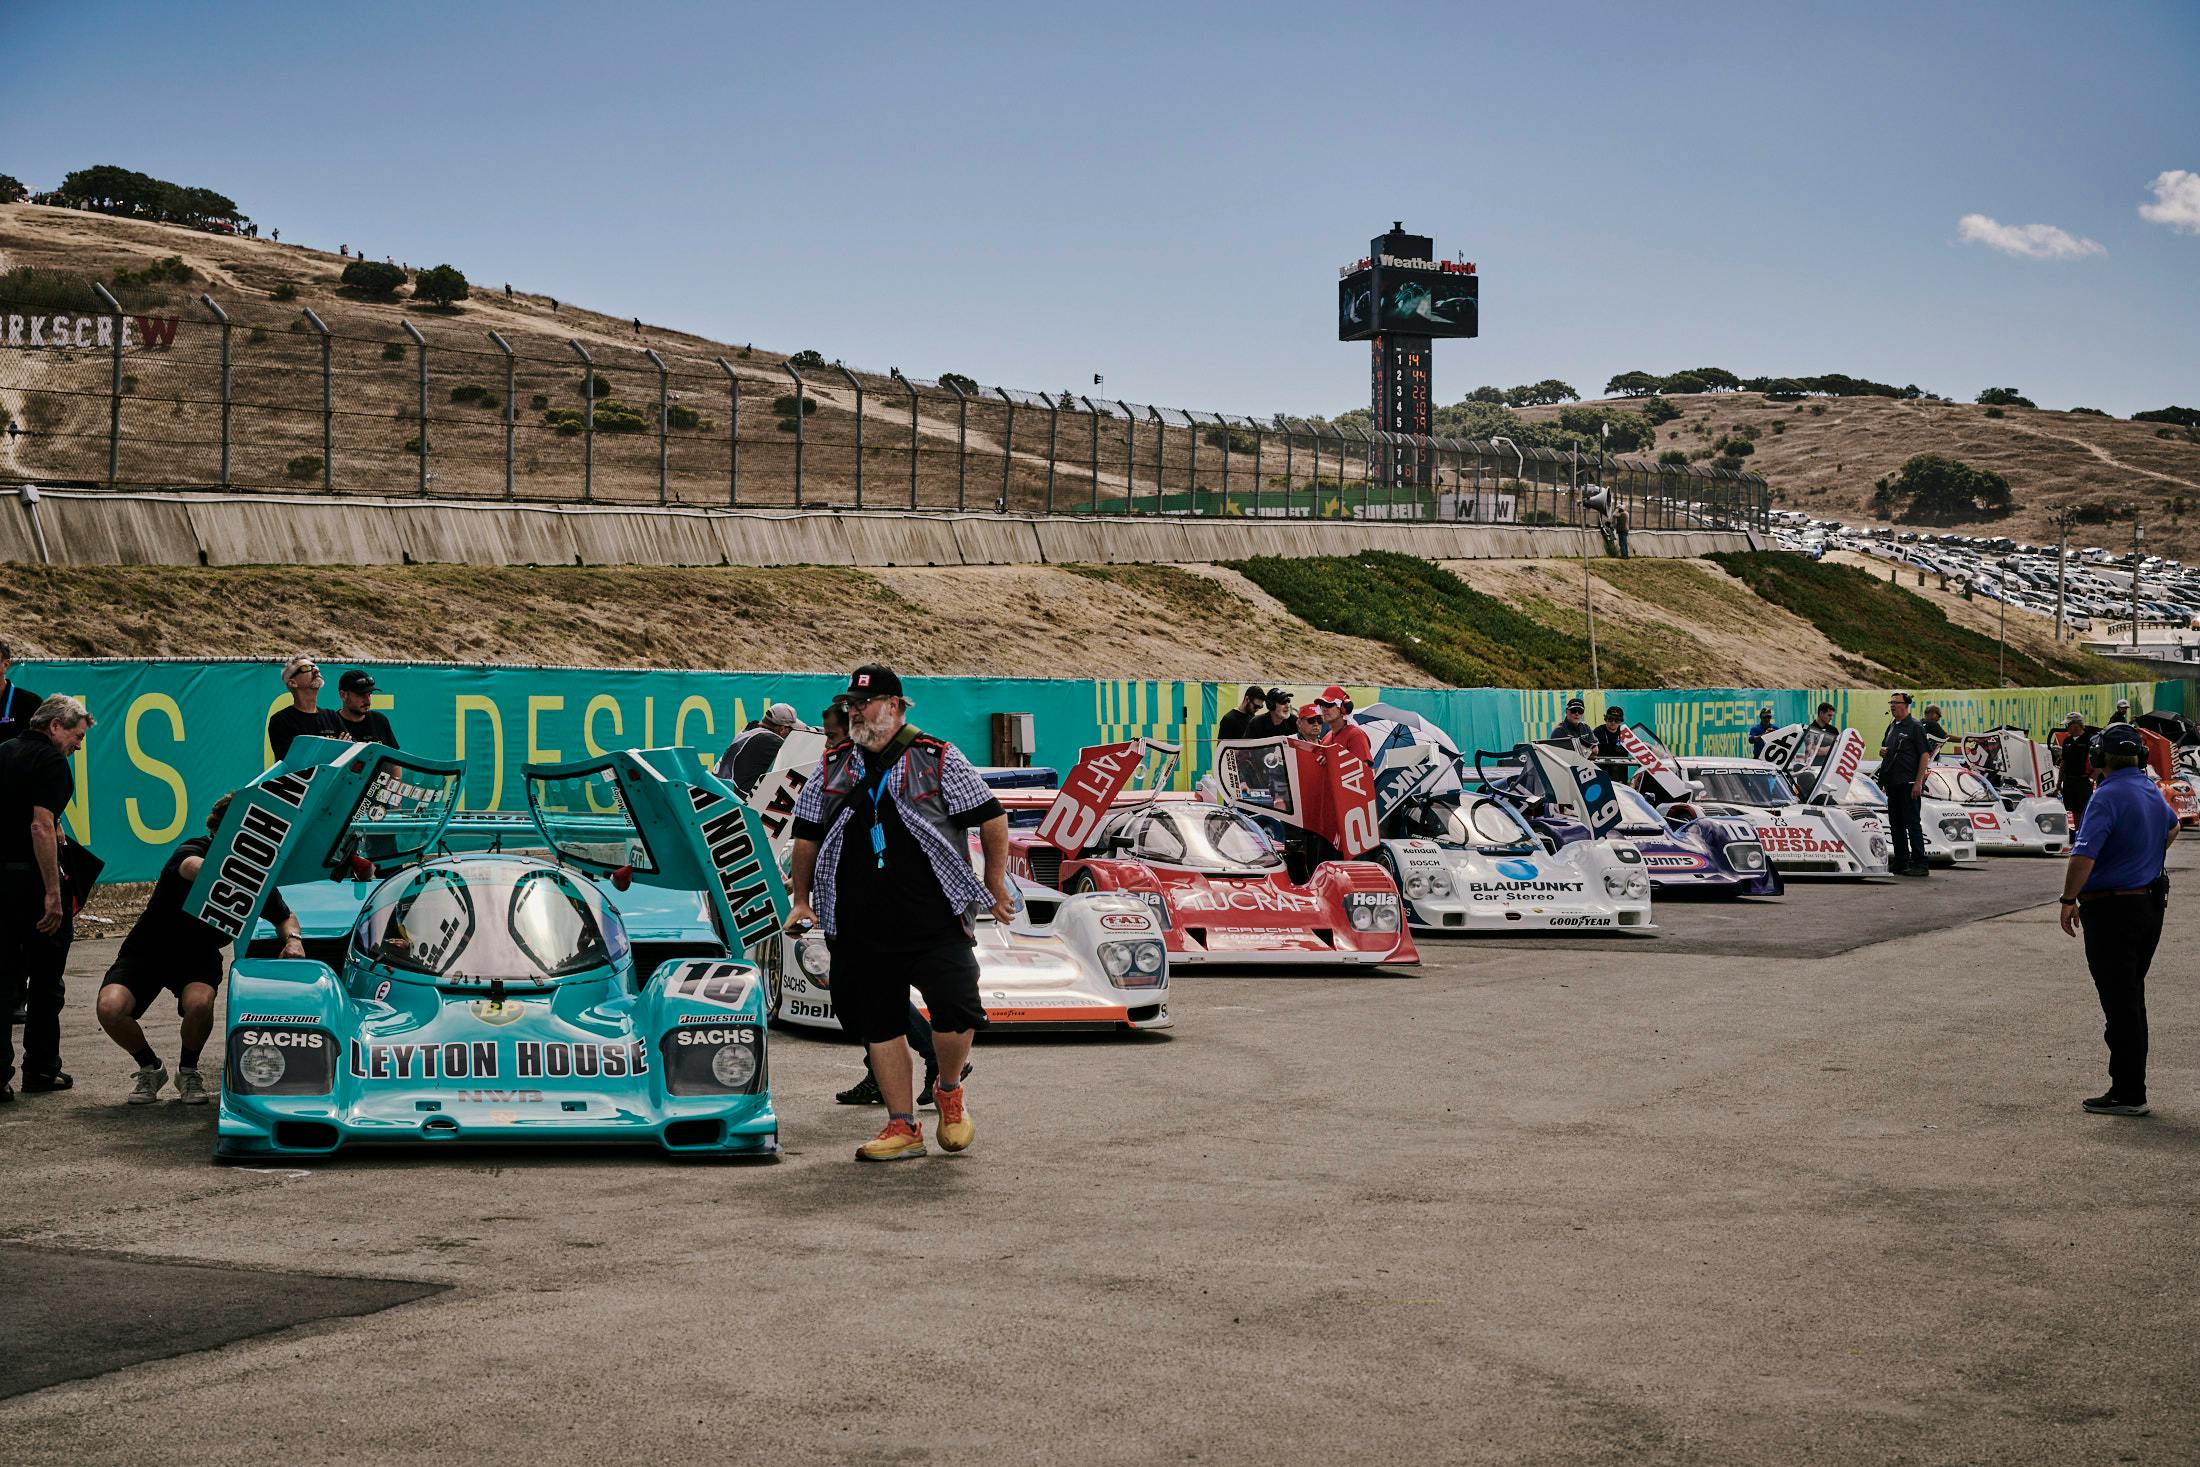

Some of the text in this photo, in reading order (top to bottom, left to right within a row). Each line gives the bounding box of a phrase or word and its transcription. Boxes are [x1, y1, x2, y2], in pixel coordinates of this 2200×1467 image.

[1380, 254, 1476, 274] WeatherTech
[0, 314, 180, 348] RKSCREW
[1397, 353, 1419, 367] 1 14
[1396, 369, 1402, 381] 2
[1396, 385, 1427, 399] 3 22
[1396, 401, 1402, 412] 4
[1396, 416, 1402, 428] 5
[1396, 448, 1402, 459] 7
[1353, 503, 1424, 519] SUNBELT
[1620, 726, 1669, 776] RUBY
[1835, 730, 1866, 785] RUBY
[1344, 800, 1380, 855] 2
[1770, 817, 1788, 827] 23
[1722, 823, 1758, 841] 10
[1755, 826, 1813, 840] RUBY
[1761, 839, 1845, 853] UESDAY
[1613, 847, 1642, 864] 6
[199, 802, 292, 939] HOUSE
[700, 806, 783, 950] LEYTON
[1469, 881, 1584, 893] BLAUPUNKT
[1176, 892, 1321, 912] ALUCRAFT
[1353, 893, 1397, 906] Hella
[1473, 892, 1555, 901] Car Stereo
[1549, 915, 1611, 928] GOODYEAR
[783, 974, 806, 994] SACHS
[240, 1013, 321, 1024] BRIDGESTONE
[680, 1014, 757, 1024] BRIDGESTONE
[243, 1031, 323, 1049] SACHS
[677, 1029, 755, 1046] SACHS
[350, 1036, 649, 1079] LEYTON HOUSE
